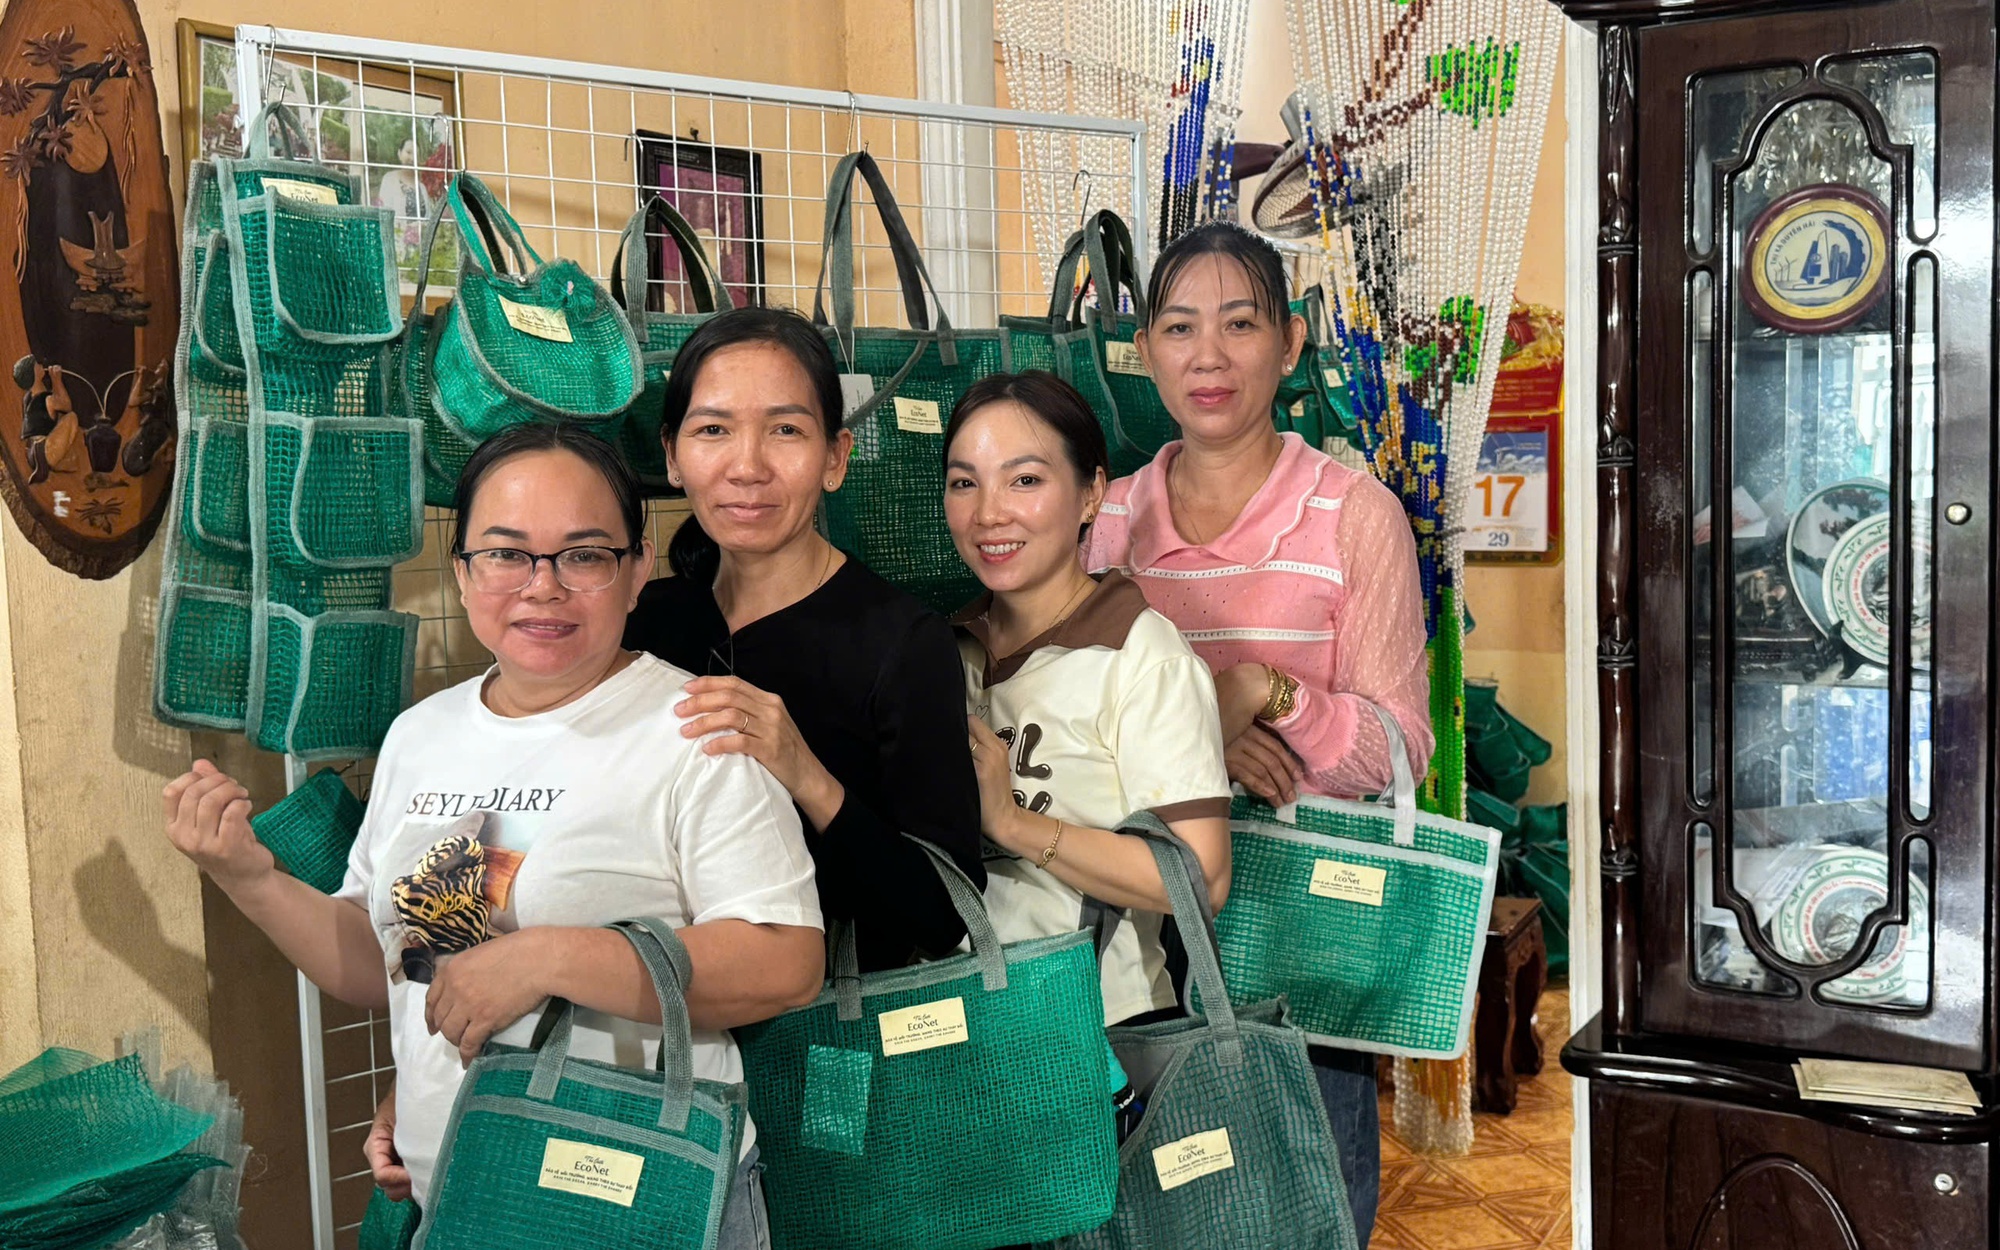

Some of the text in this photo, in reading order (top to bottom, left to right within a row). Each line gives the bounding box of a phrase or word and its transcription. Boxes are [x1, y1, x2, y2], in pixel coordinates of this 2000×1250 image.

[1474, 475, 1526, 517] 17
[1488, 531, 1509, 547] 29
[1334, 874, 1360, 885] EcoNet
[907, 1019, 938, 1031] EcoNet
[1178, 1148, 1205, 1163] EcoNet
[574, 1161, 609, 1176] EcoNet
